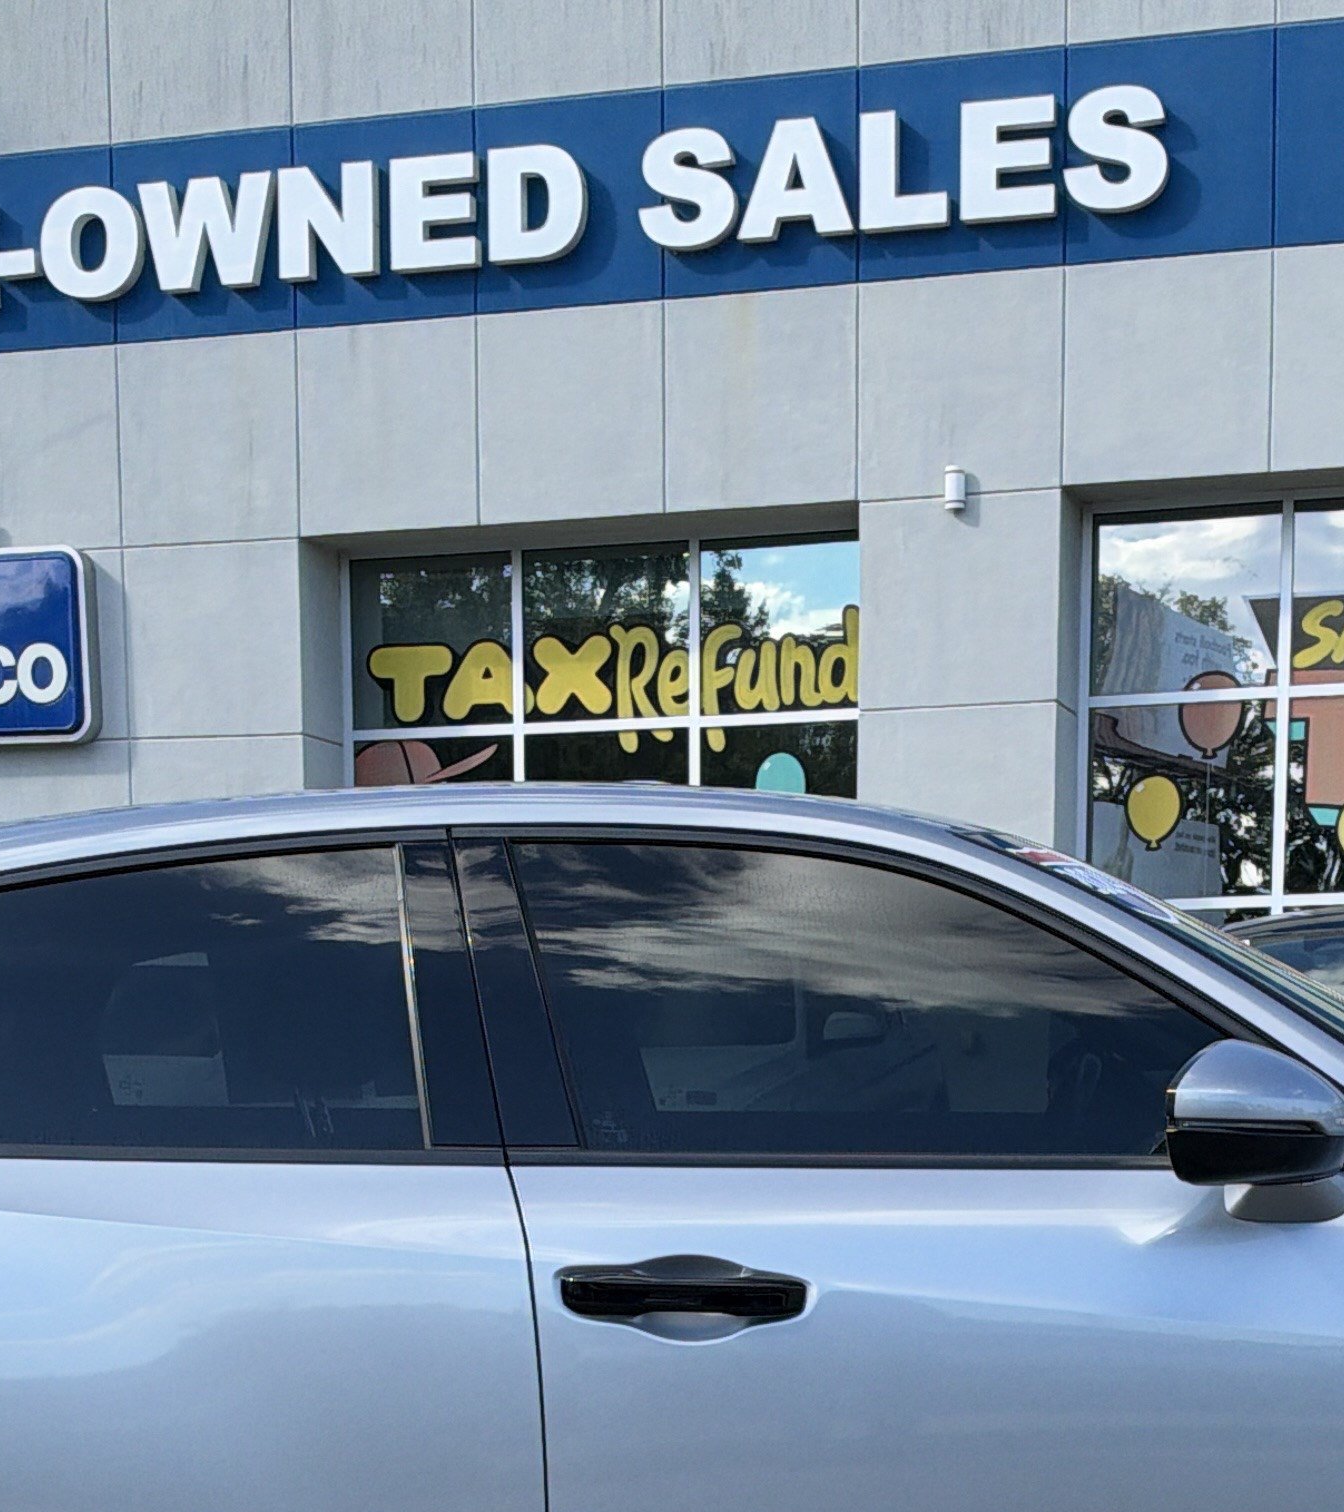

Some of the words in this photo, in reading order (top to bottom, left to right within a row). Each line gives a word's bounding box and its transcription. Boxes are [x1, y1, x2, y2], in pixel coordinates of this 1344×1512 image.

[639, 85, 1169, 252] SALES
[368, 634, 613, 722] TAX
[610, 605, 859, 753] Refund
